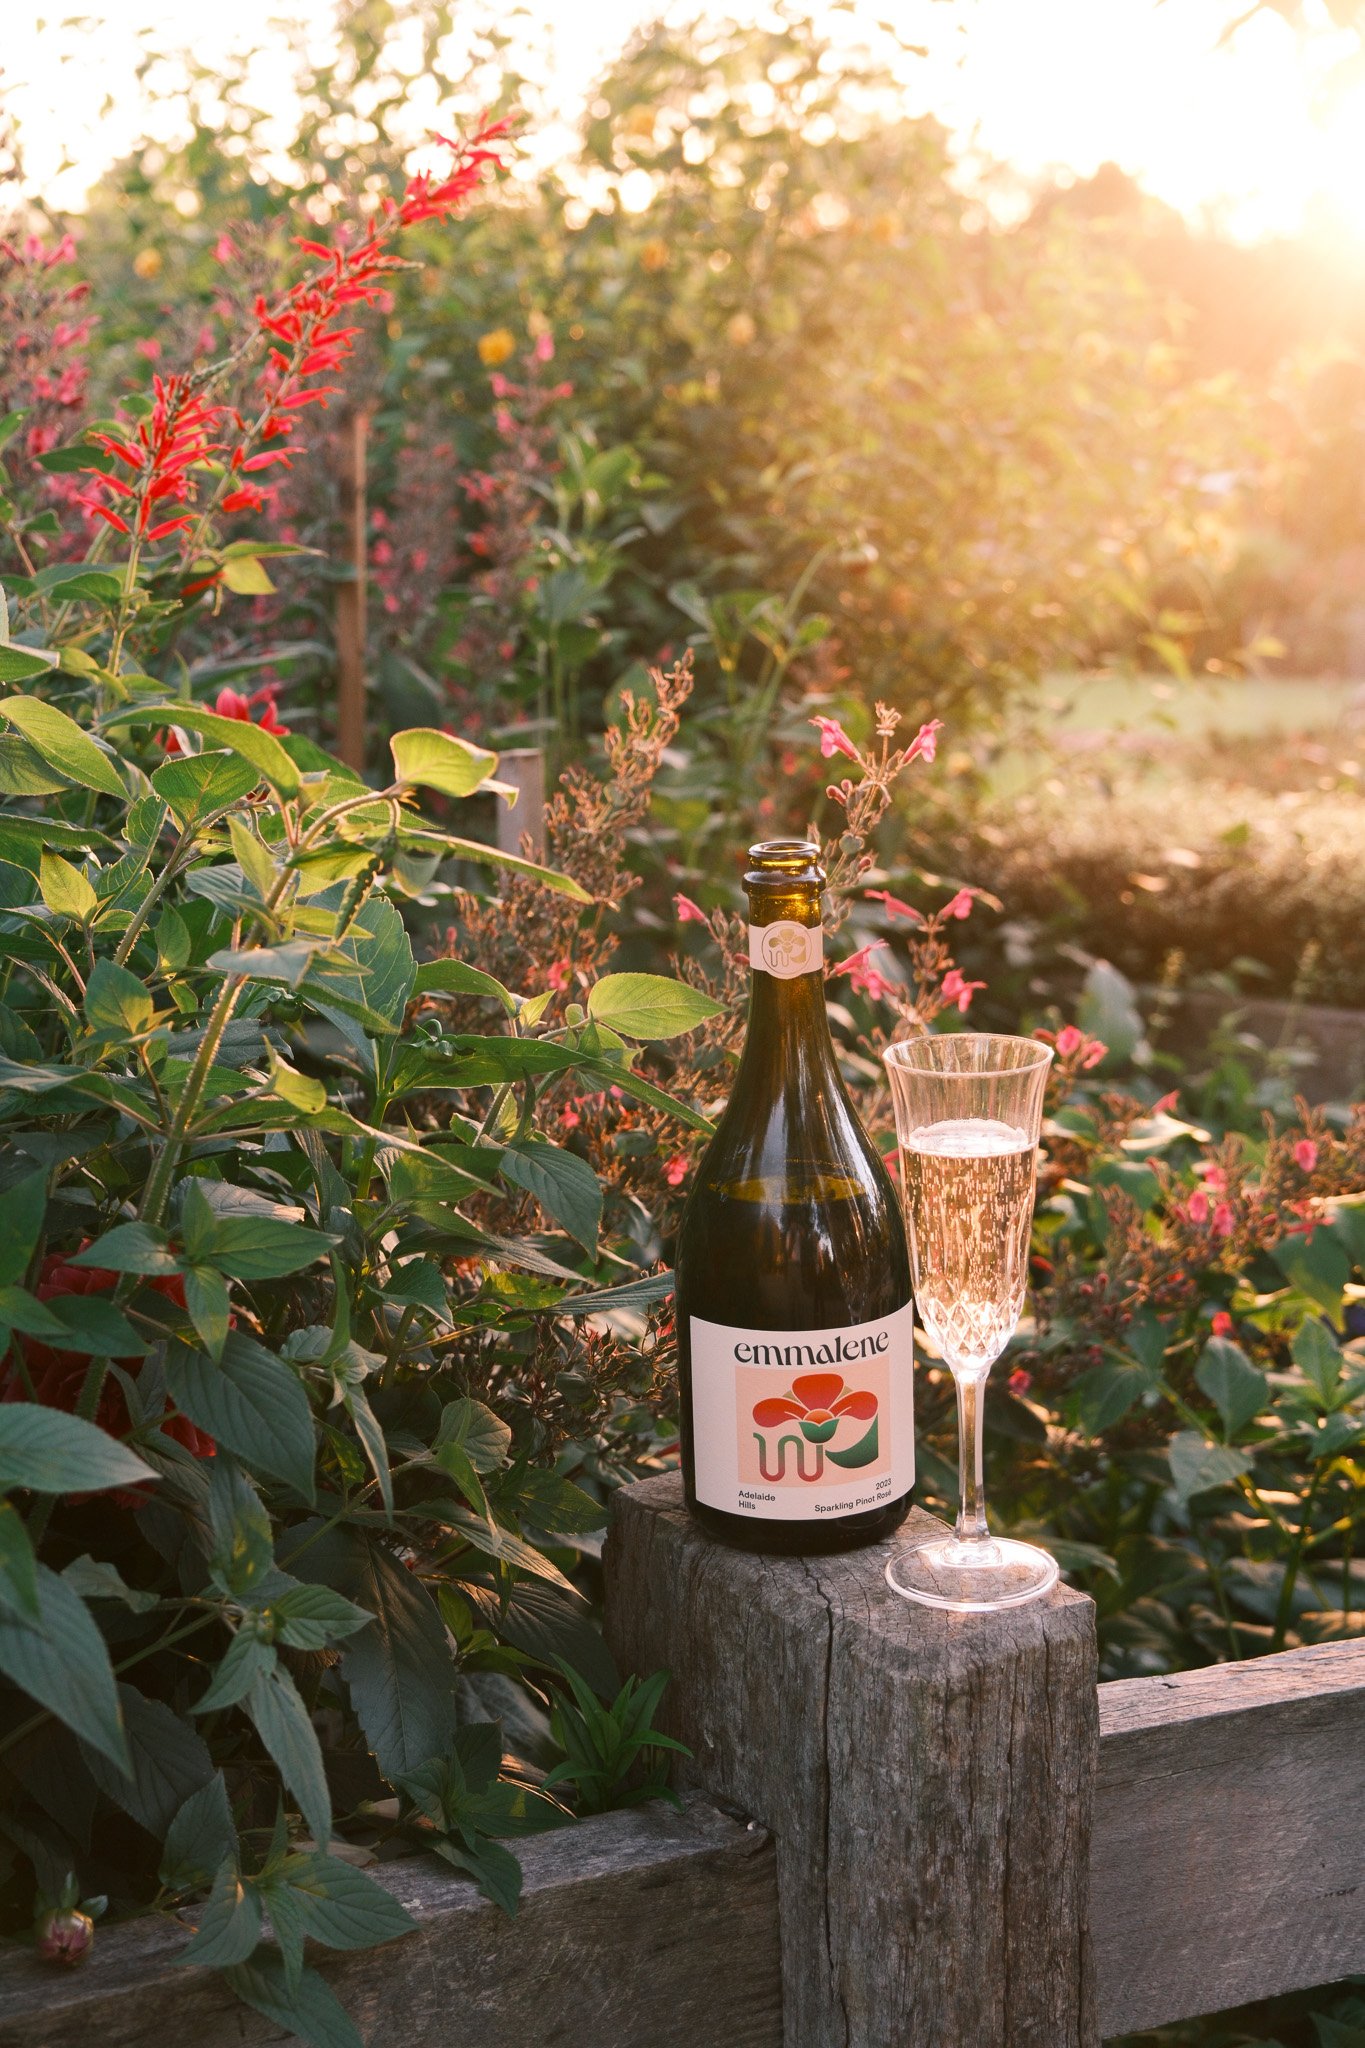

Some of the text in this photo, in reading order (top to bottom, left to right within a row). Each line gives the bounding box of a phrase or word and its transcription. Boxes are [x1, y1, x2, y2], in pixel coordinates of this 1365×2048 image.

[734, 1331, 890, 1366] emmalene
[875, 1478, 892, 1490] 2023
[738, 1490, 776, 1502] Adelaide
[814, 1489, 892, 1514] Sparkling Pinot Rosé
[738, 1500, 756, 1510] Hills
